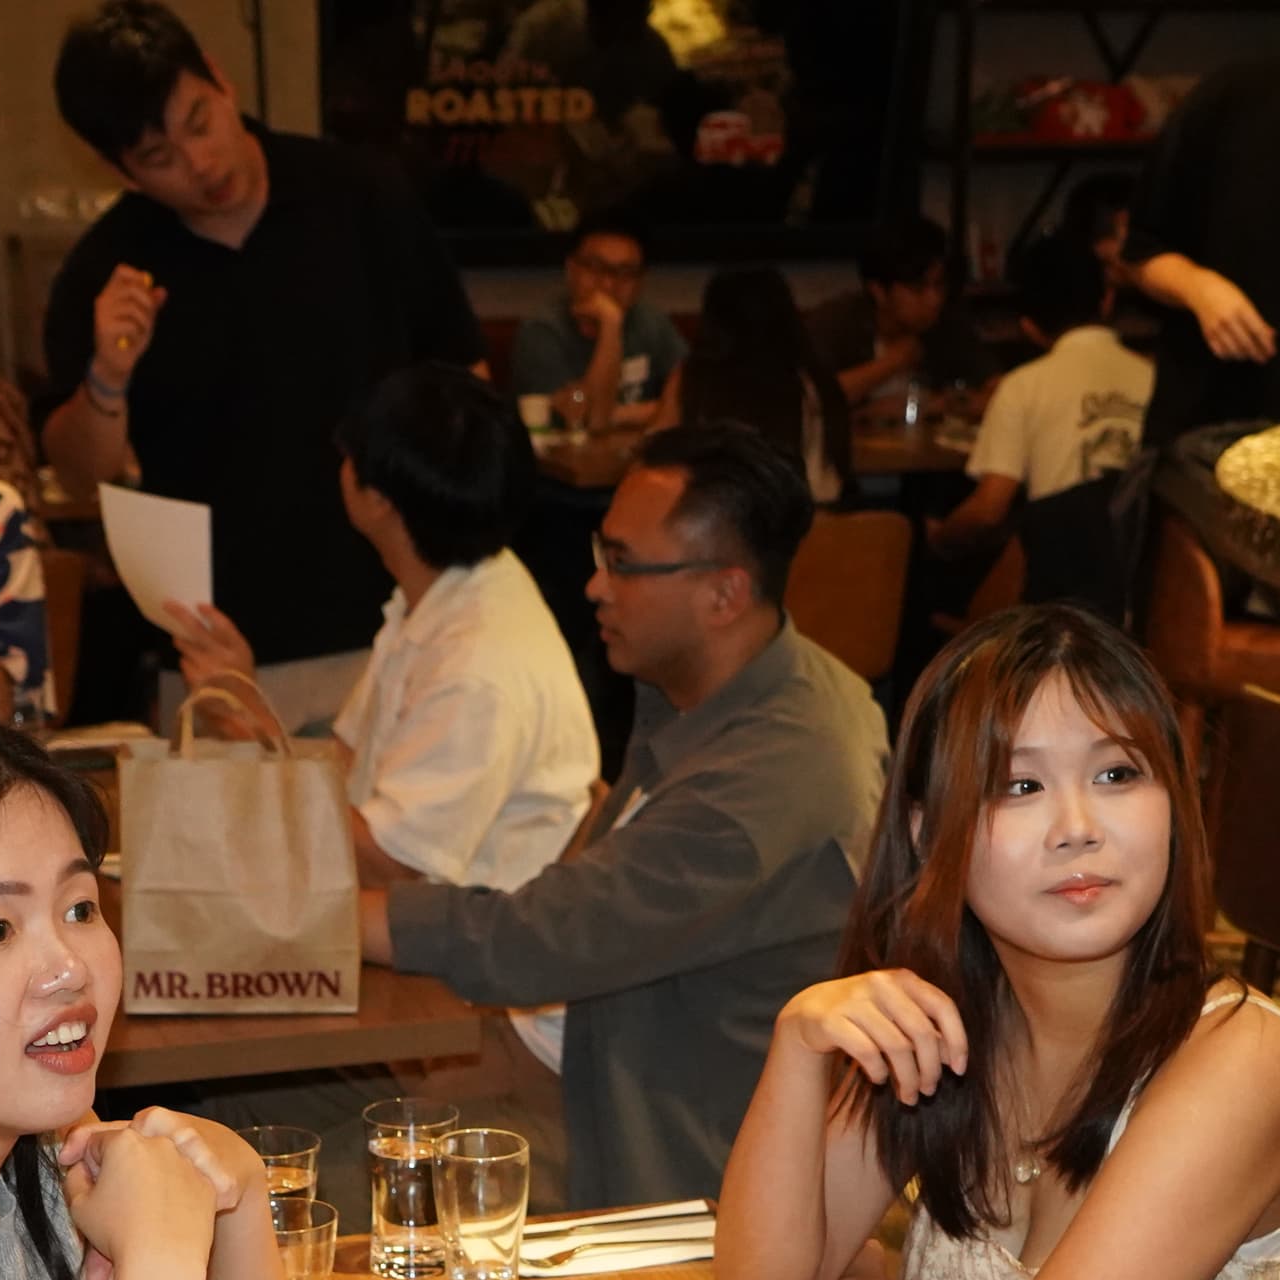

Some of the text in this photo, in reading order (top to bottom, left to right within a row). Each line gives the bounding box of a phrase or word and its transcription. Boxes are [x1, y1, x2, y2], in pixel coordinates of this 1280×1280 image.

[404, 86, 596, 125] ROASTED
[133, 969, 342, 999] MR. BROWN
